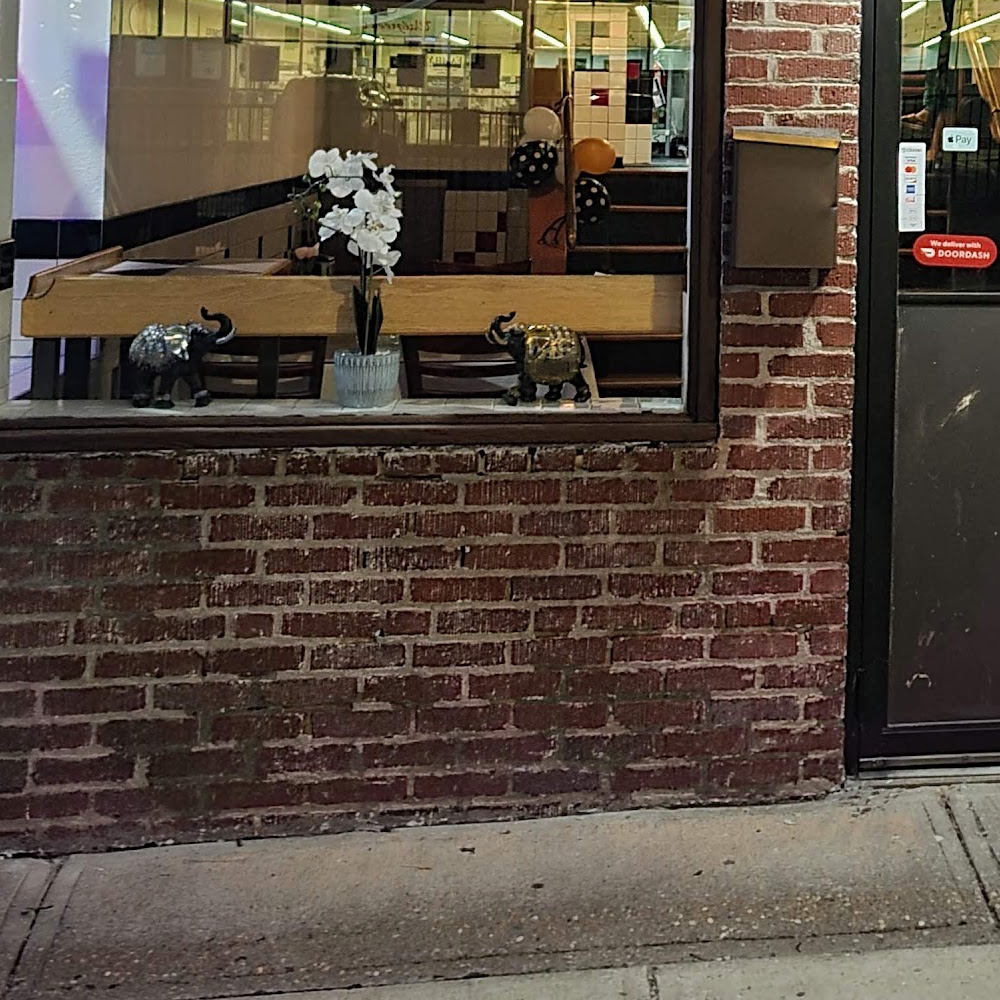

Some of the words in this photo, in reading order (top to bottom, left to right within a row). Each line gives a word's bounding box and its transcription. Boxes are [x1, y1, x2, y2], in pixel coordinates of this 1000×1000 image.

[955, 134, 972, 146] Pay
[930, 239, 942, 247] We
[943, 240, 966, 248] deliver
[938, 249, 990, 260] DOORDASH
